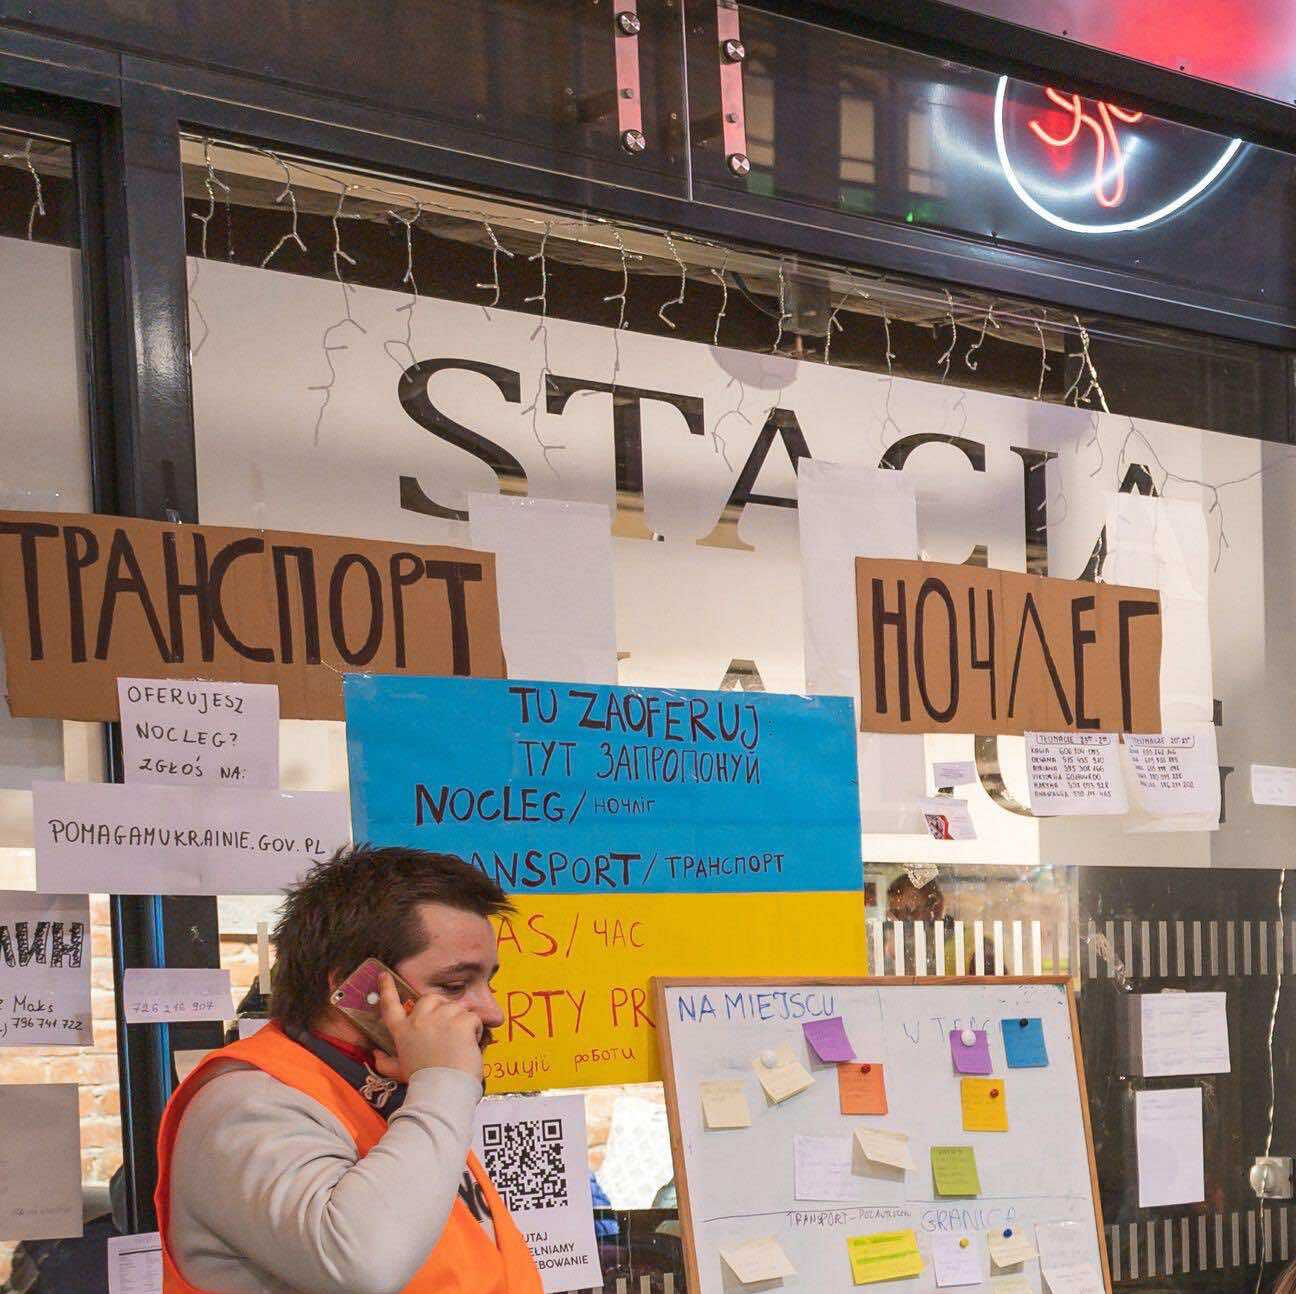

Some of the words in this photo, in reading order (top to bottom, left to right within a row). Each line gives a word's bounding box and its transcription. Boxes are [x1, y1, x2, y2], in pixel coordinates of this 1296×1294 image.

[0, 522, 482, 677] ТРАНСПОРТ
[871, 576, 1160, 734] НОЧЛЕГ
[128, 686, 246, 714] OFERUJESZ
[509, 687, 558, 724] TU
[137, 723, 239, 748] NOCLEG?
[139, 755, 204, 778] ZGŁOŚ
[519, 740, 576, 777] ТУТ
[597, 741, 761, 785] ЗАПРОПОНУЙ
[48, 818, 326, 855] POMAGAMUKRAINIE.GOV.PL
[665, 854, 784, 880] ТРАНСПОРТ
[594, 919, 645, 948] ЧАС
[13, 995, 53, 1013] Maks
[678, 993, 716, 1022] NA
[724, 992, 836, 1022] MIEJSCU
